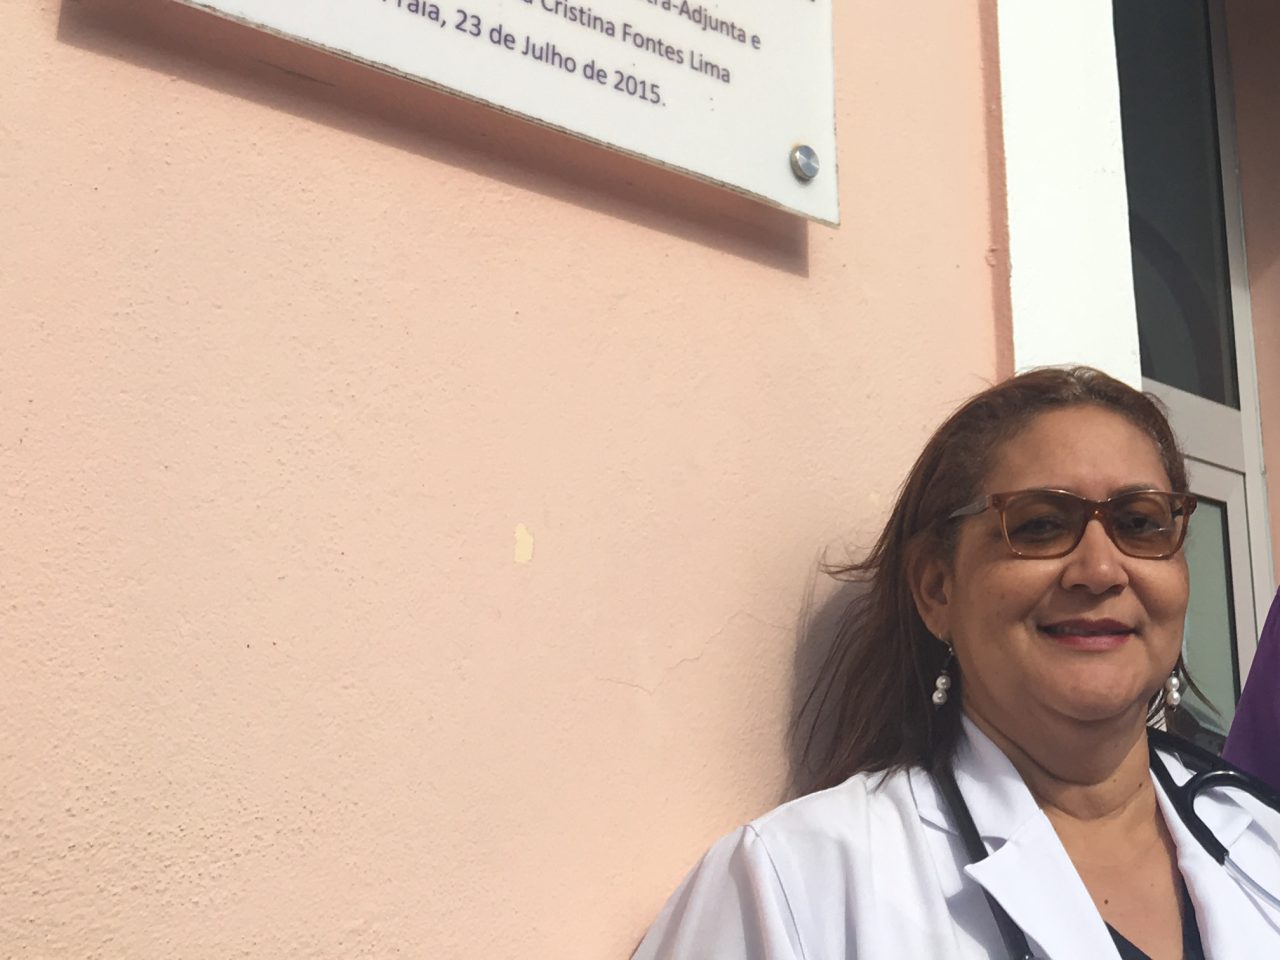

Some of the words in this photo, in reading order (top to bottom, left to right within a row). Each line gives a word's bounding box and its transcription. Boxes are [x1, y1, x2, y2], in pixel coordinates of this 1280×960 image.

[454, 8, 482, 38] 23
[488, 23, 517, 51] de
[520, 35, 577, 74] Julho
[582, 59, 608, 86] de
[613, 69, 667, 108] 2015.
[622, 22, 685, 65] Fontes
[689, 49, 731, 85] Lima
[750, 34, 762, 51] e
